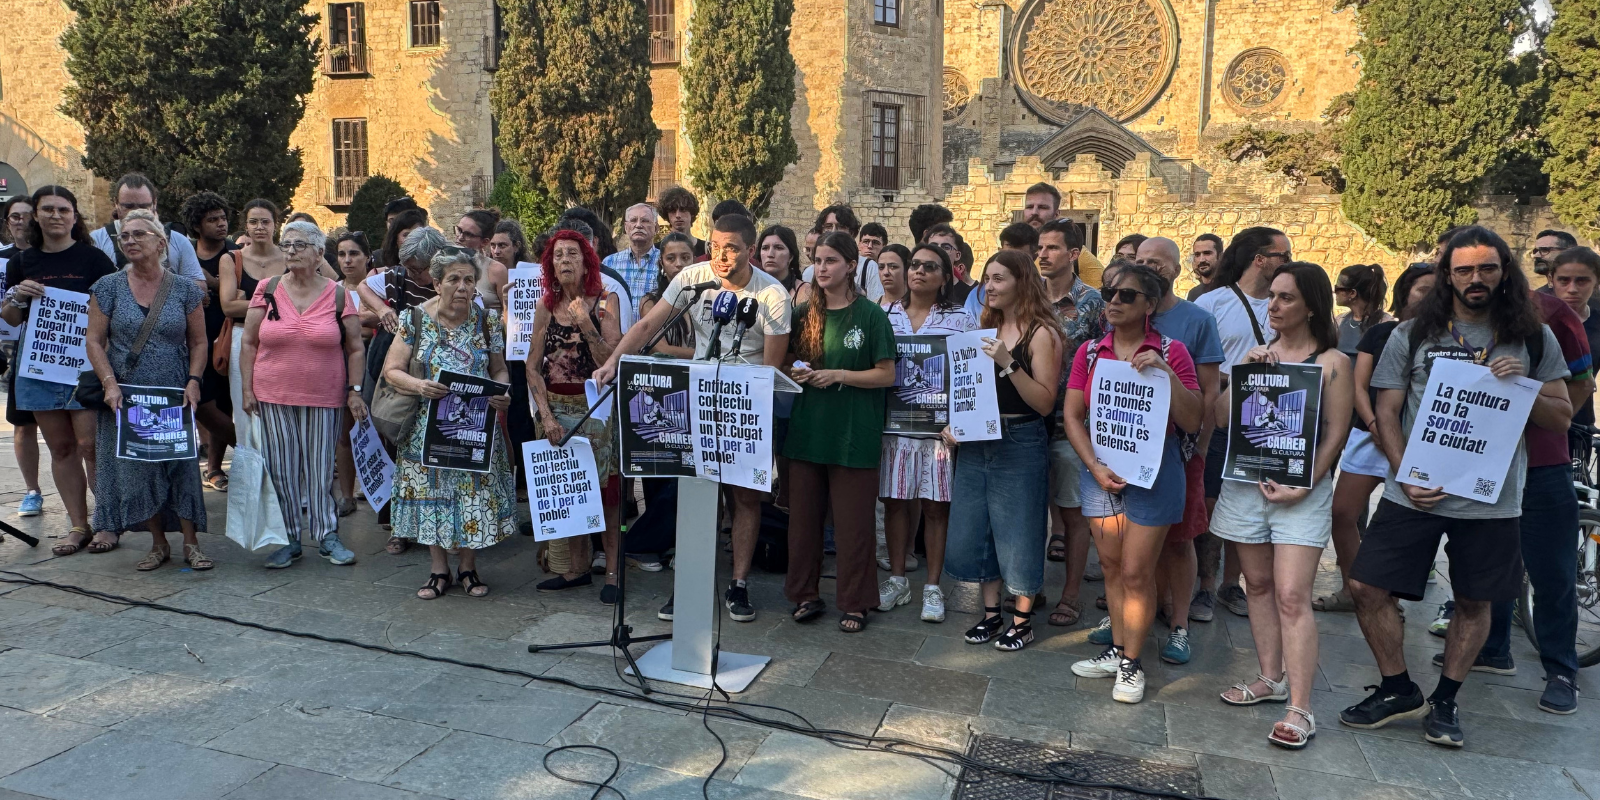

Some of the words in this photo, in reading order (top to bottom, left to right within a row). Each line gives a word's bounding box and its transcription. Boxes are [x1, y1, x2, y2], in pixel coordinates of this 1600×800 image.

[40, 296, 56, 308] Ets
[514, 289, 524, 299] de
[38, 307, 51, 318] de
[54, 310, 78, 323] Sant
[514, 310, 531, 320] vols
[36, 318, 66, 332] Cugat
[69, 323, 72, 334] i
[75, 326, 87, 336] no
[35, 329, 56, 342] vols
[59, 334, 83, 346] anar
[32, 340, 68, 354] dormir
[896, 343, 932, 354] CULTURA
[30, 352, 37, 361] a
[40, 352, 56, 364] les
[58, 355, 85, 368] 23h?
[962, 361, 968, 373] al
[634, 374, 672, 388] CULTURA
[698, 379, 742, 395] Entitats
[746, 381, 749, 395] i
[954, 374, 975, 387] carrer,
[976, 372, 983, 384] la
[1098, 377, 1111, 392] La
[1114, 380, 1154, 398] cultura
[1248, 374, 1290, 388] CULTURA
[450, 382, 484, 394] CULTURA
[954, 387, 976, 400] cultura
[130, 394, 168, 405] CULTURA
[916, 393, 948, 404] CARRER
[954, 398, 976, 412] també!
[1098, 392, 1111, 406] no
[1114, 395, 1152, 413] només
[1436, 382, 1454, 400] La
[1456, 388, 1510, 412] cultura
[1431, 399, 1450, 414] no
[1453, 402, 1470, 418] fa
[699, 408, 737, 424] undes
[740, 413, 759, 426] per
[1096, 406, 1146, 428] s'admira,
[1426, 414, 1474, 435] soroll:
[457, 430, 487, 442] CARRER
[700, 424, 713, 435] un
[1096, 420, 1108, 433] es
[1111, 422, 1126, 437] viu
[1129, 424, 1134, 438] i
[1136, 428, 1149, 441] es
[700, 436, 714, 448] de
[724, 440, 742, 452] per
[746, 441, 756, 454] al
[1096, 433, 1139, 454] defensa.
[1267, 436, 1306, 451] CARRER
[1421, 427, 1437, 444] fa
[1439, 432, 1488, 454] ciutat!
[531, 448, 568, 463] Entitats
[570, 447, 574, 458] i
[533, 458, 579, 475] col·lectiu
[534, 472, 568, 486] unides
[571, 470, 587, 483] per
[536, 488, 548, 498] un
[551, 480, 592, 496] St.Cugat
[538, 499, 550, 510] de
[552, 497, 556, 508] i
[559, 495, 575, 508] per
[578, 493, 587, 504] al
[539, 507, 570, 524] poble!
